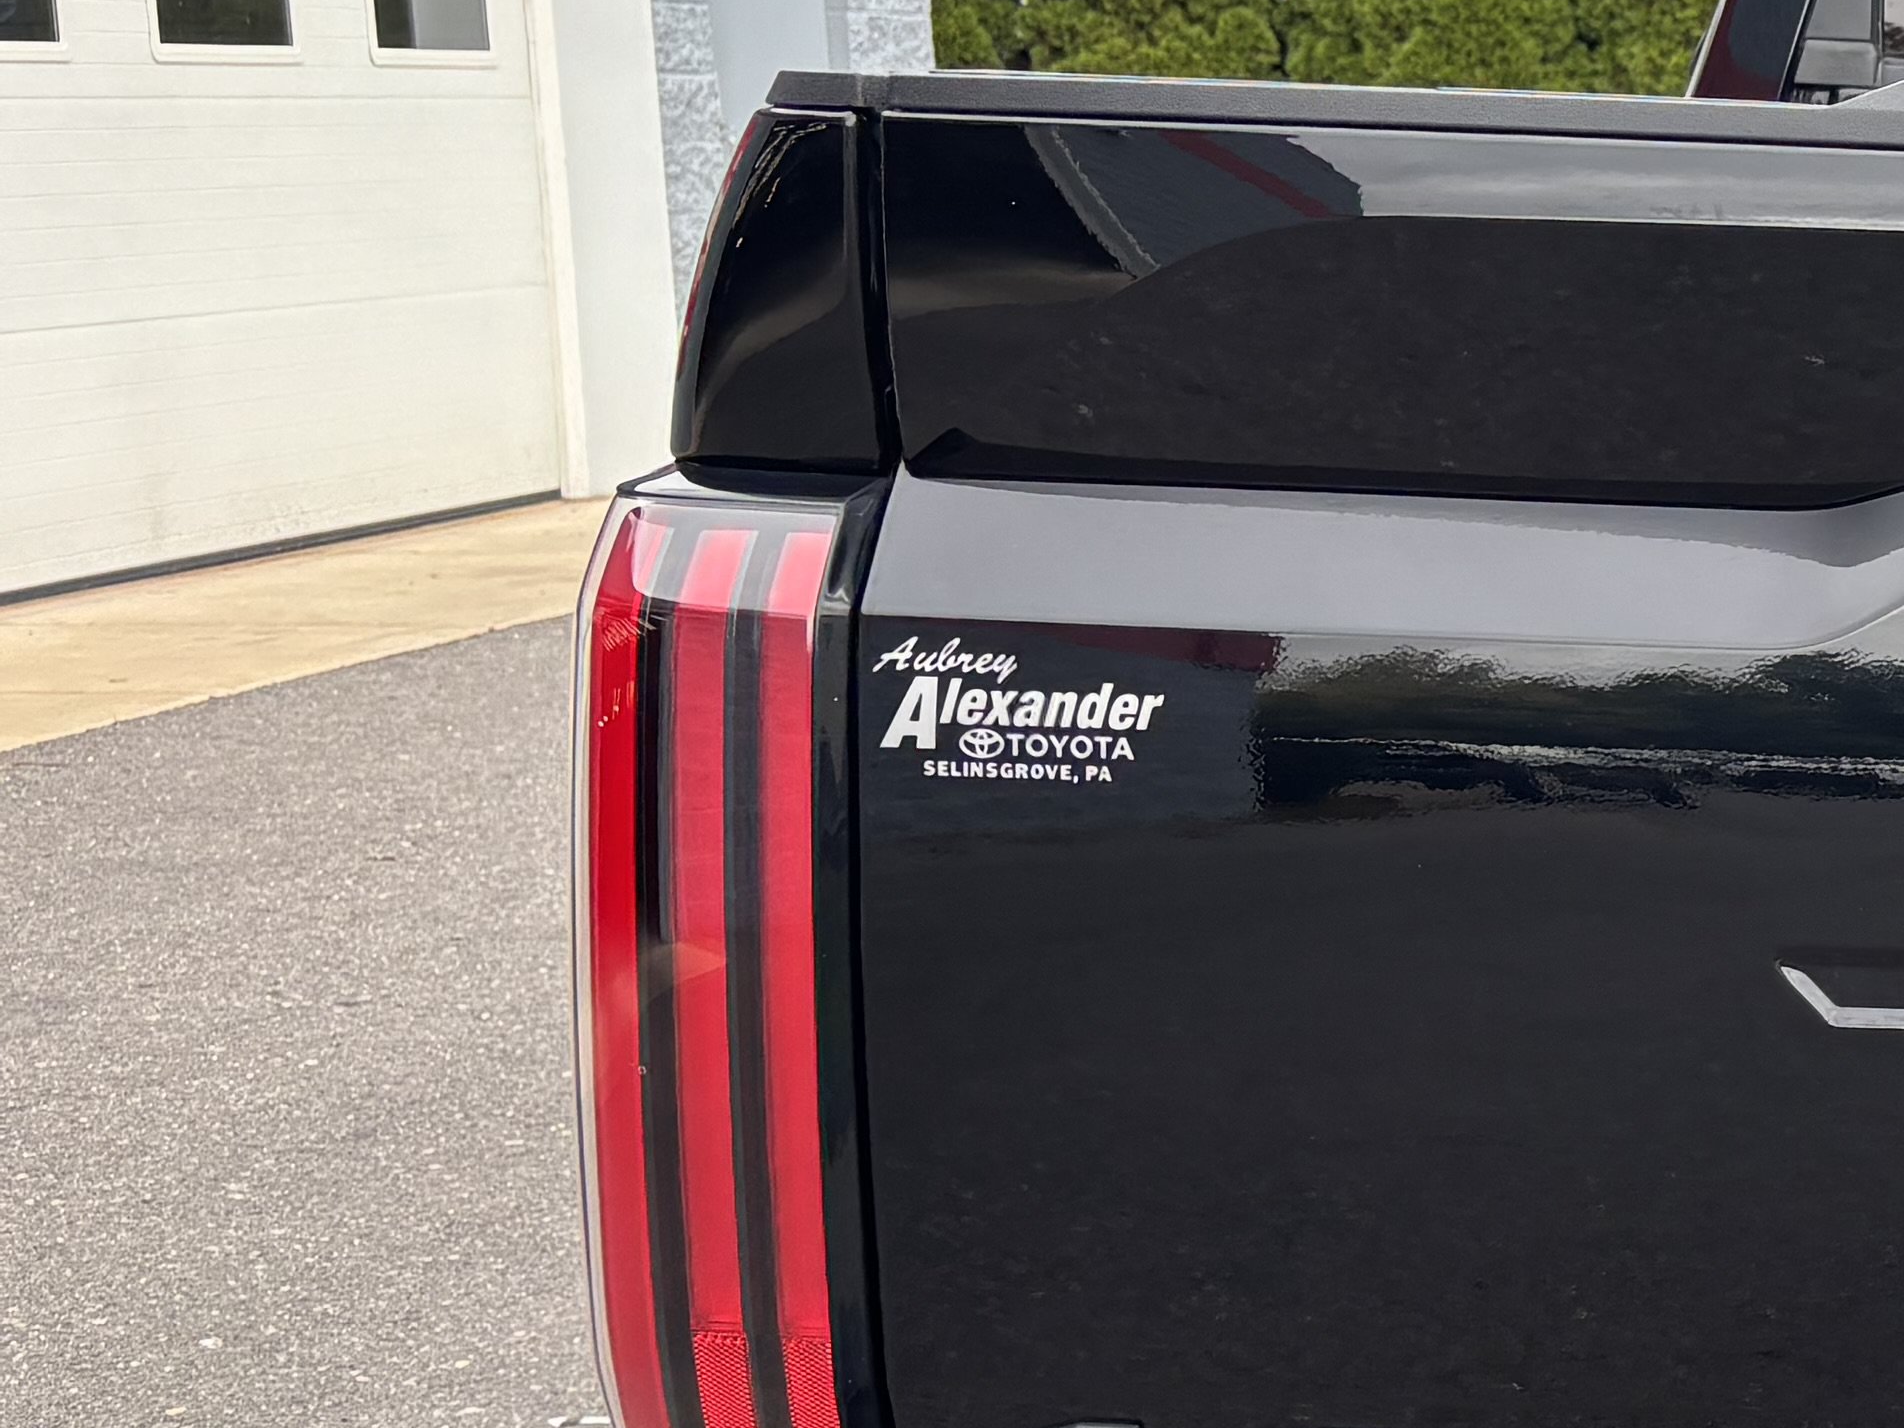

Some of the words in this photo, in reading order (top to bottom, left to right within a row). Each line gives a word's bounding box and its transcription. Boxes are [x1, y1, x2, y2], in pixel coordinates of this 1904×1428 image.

[872, 636, 1018, 683] Aubrey
[879, 676, 1165, 749] Alexander
[1006, 733, 1135, 761] TOYOTA
[923, 759, 1079, 784] SELINSGROVE,
[1085, 765, 1113, 782] PA
